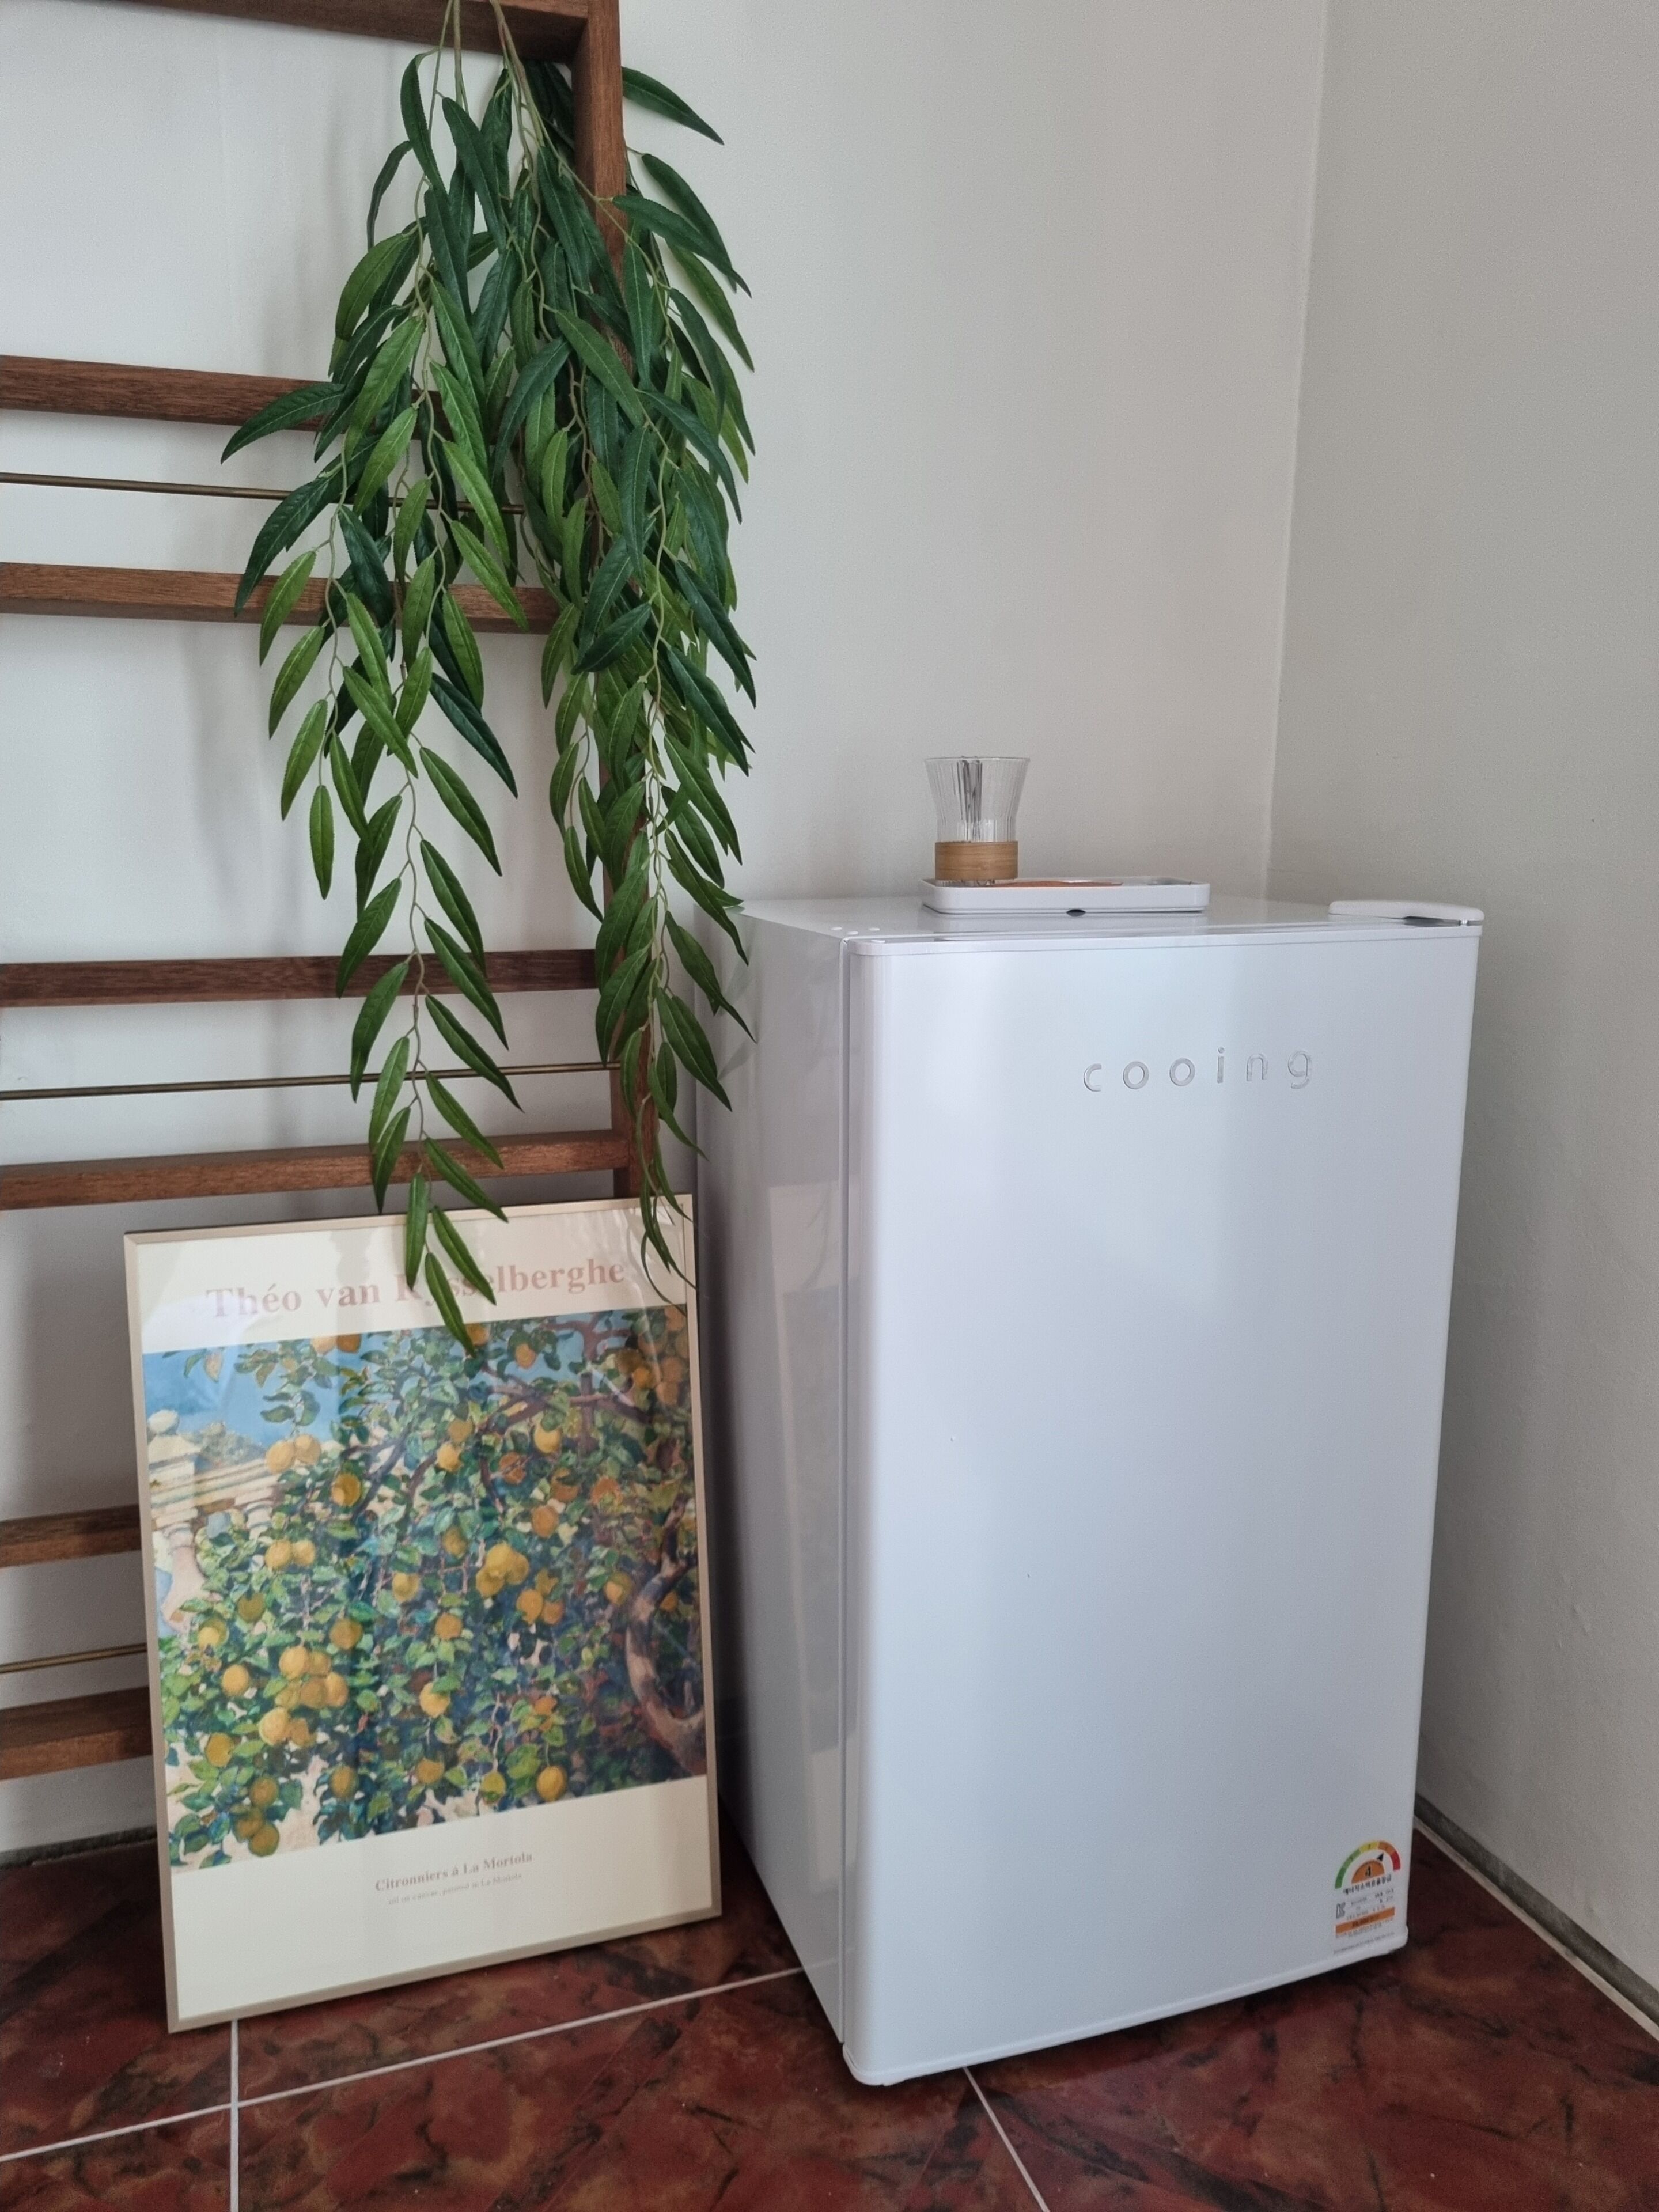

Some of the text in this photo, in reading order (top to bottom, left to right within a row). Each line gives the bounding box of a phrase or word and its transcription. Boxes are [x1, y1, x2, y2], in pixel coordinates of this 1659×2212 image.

[1083, 1046, 1312, 1092] cooing
[206, 1283, 302, 1317] Théo
[316, 1283, 380, 1308] van
